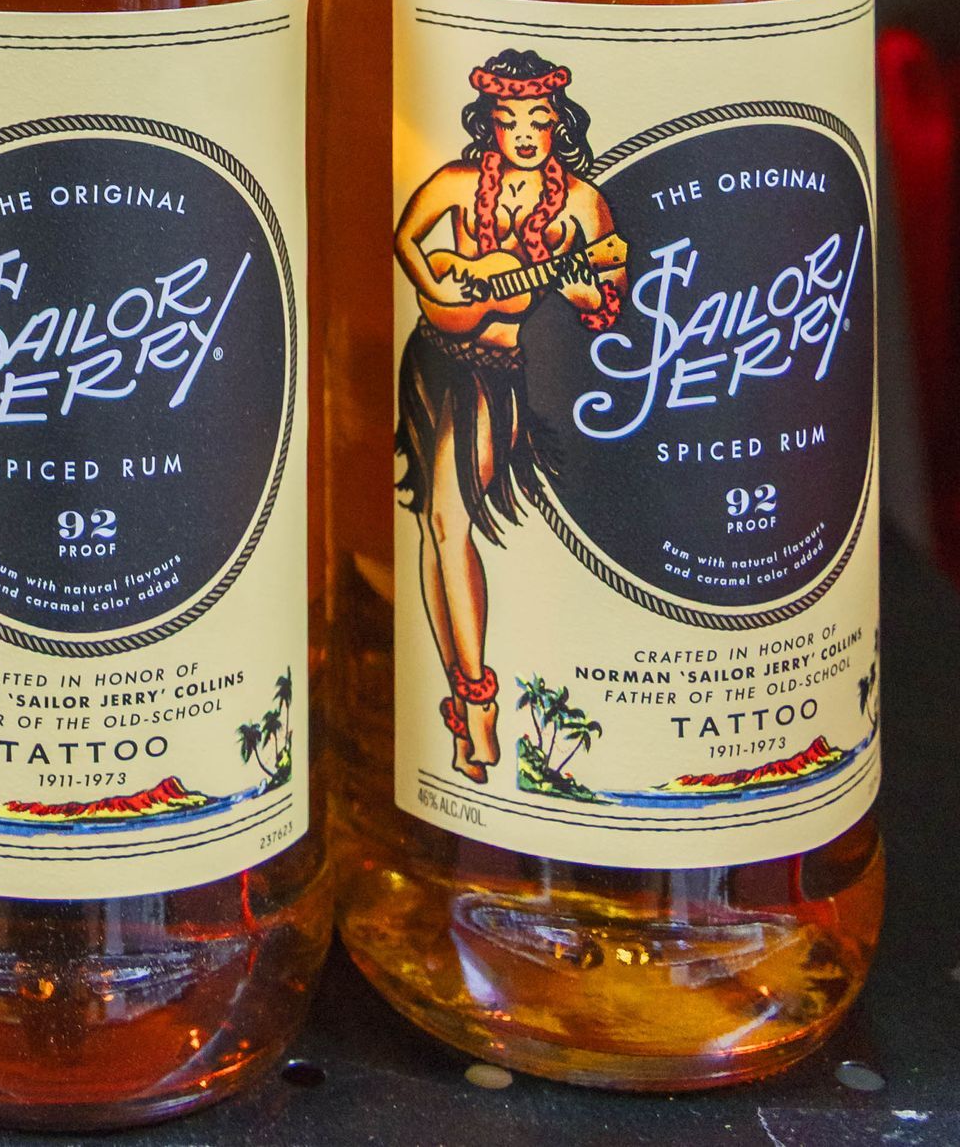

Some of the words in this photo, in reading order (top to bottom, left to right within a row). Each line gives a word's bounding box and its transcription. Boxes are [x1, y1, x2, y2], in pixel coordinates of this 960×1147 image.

[50, 184, 186, 214] ORIGINAL
[652, 181, 702, 211] THE
[719, 168, 826, 193] ORIGINAL
[591, 233, 843, 378] SAILOR
[657, 438, 761, 462] SPICED
[781, 425, 825, 452] RUM
[123, 454, 181, 477] RUM
[726, 484, 777, 516] 92
[58, 510, 117, 539] 92
[728, 516, 776, 533] PROOF
[59, 543, 116, 557] PROOF
[663, 541, 689, 560] Rum
[698, 554, 725, 568] with
[732, 552, 778, 568] natural
[783, 522, 825, 557] flavours
[26, 575, 56, 592] with
[64, 580, 118, 594] natural
[125, 554, 181, 587] flavours
[665, 562, 690, 578] and
[697, 572, 750, 586] caramel
[757, 566, 788, 583] color
[794, 539, 824, 570] added
[26, 594, 85, 612] caramel
[93, 596, 130, 611] color
[139, 573, 179, 600] added
[575, 666, 670, 684] NORMAN
[821, 626, 863, 661] COLLINS
[634, 649, 717, 663] CRAFTED
[729, 646, 748, 660] IN
[759, 633, 814, 657] HONOR
[822, 623, 837, 641] OF
[61, 675, 82, 687] IN
[95, 669, 166, 687] HONOR
[173, 662, 199, 682] OF
[174, 671, 245, 698] COLLINS
[605, 690, 677, 704] FATHER
[689, 691, 712, 704] OF
[726, 686, 756, 701] THE
[766, 657, 851, 697] OLD-SCHOOL
[18, 716, 44, 729] OF
[56, 717, 90, 730] THE
[104, 698, 223, 728] OLD-SCHOOL
[671, 698, 818, 738] TATTOO
[709, 736, 786, 758] 1911-1973
[39, 772, 127, 788] 1911-1973
[260, 822, 292, 850] 237623
